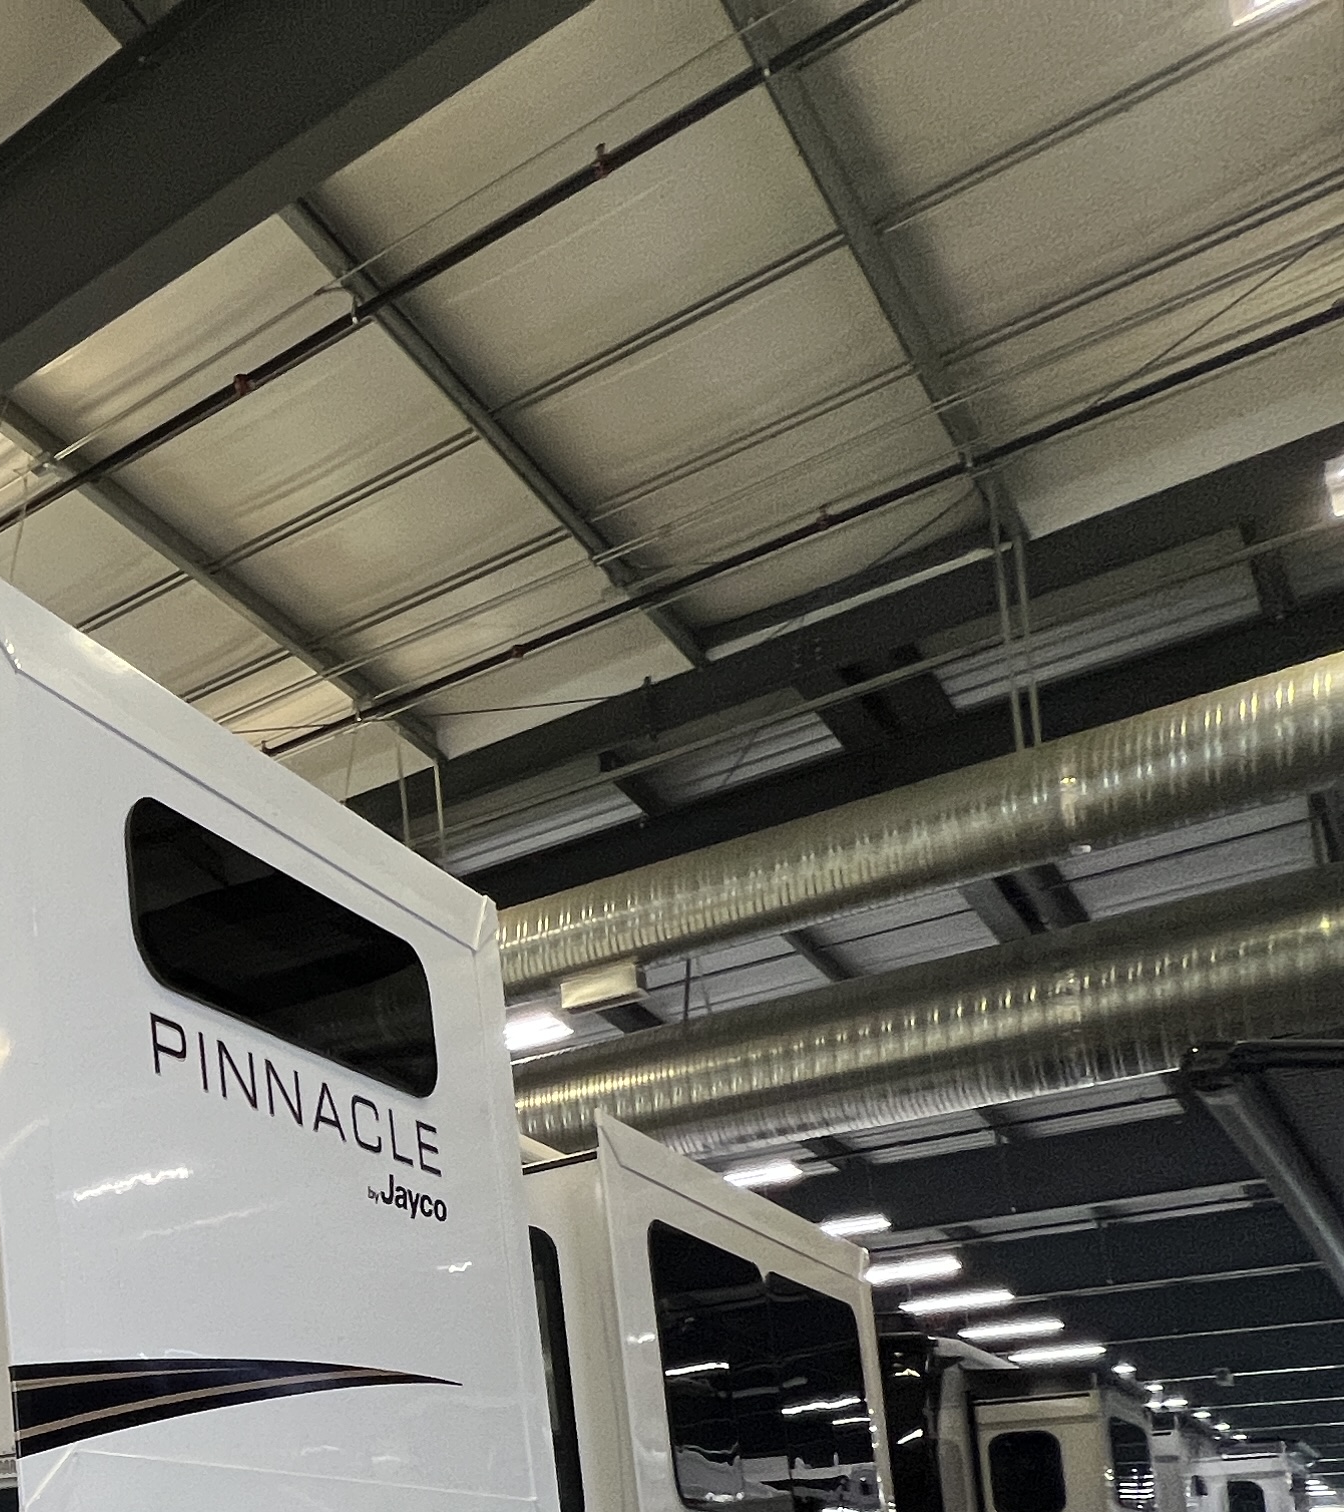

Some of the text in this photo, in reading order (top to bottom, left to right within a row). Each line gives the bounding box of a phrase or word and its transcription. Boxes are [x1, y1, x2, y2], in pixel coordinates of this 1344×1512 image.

[149, 1011, 442, 1177] PINNACLE
[368, 1174, 447, 1221] by Jayco
